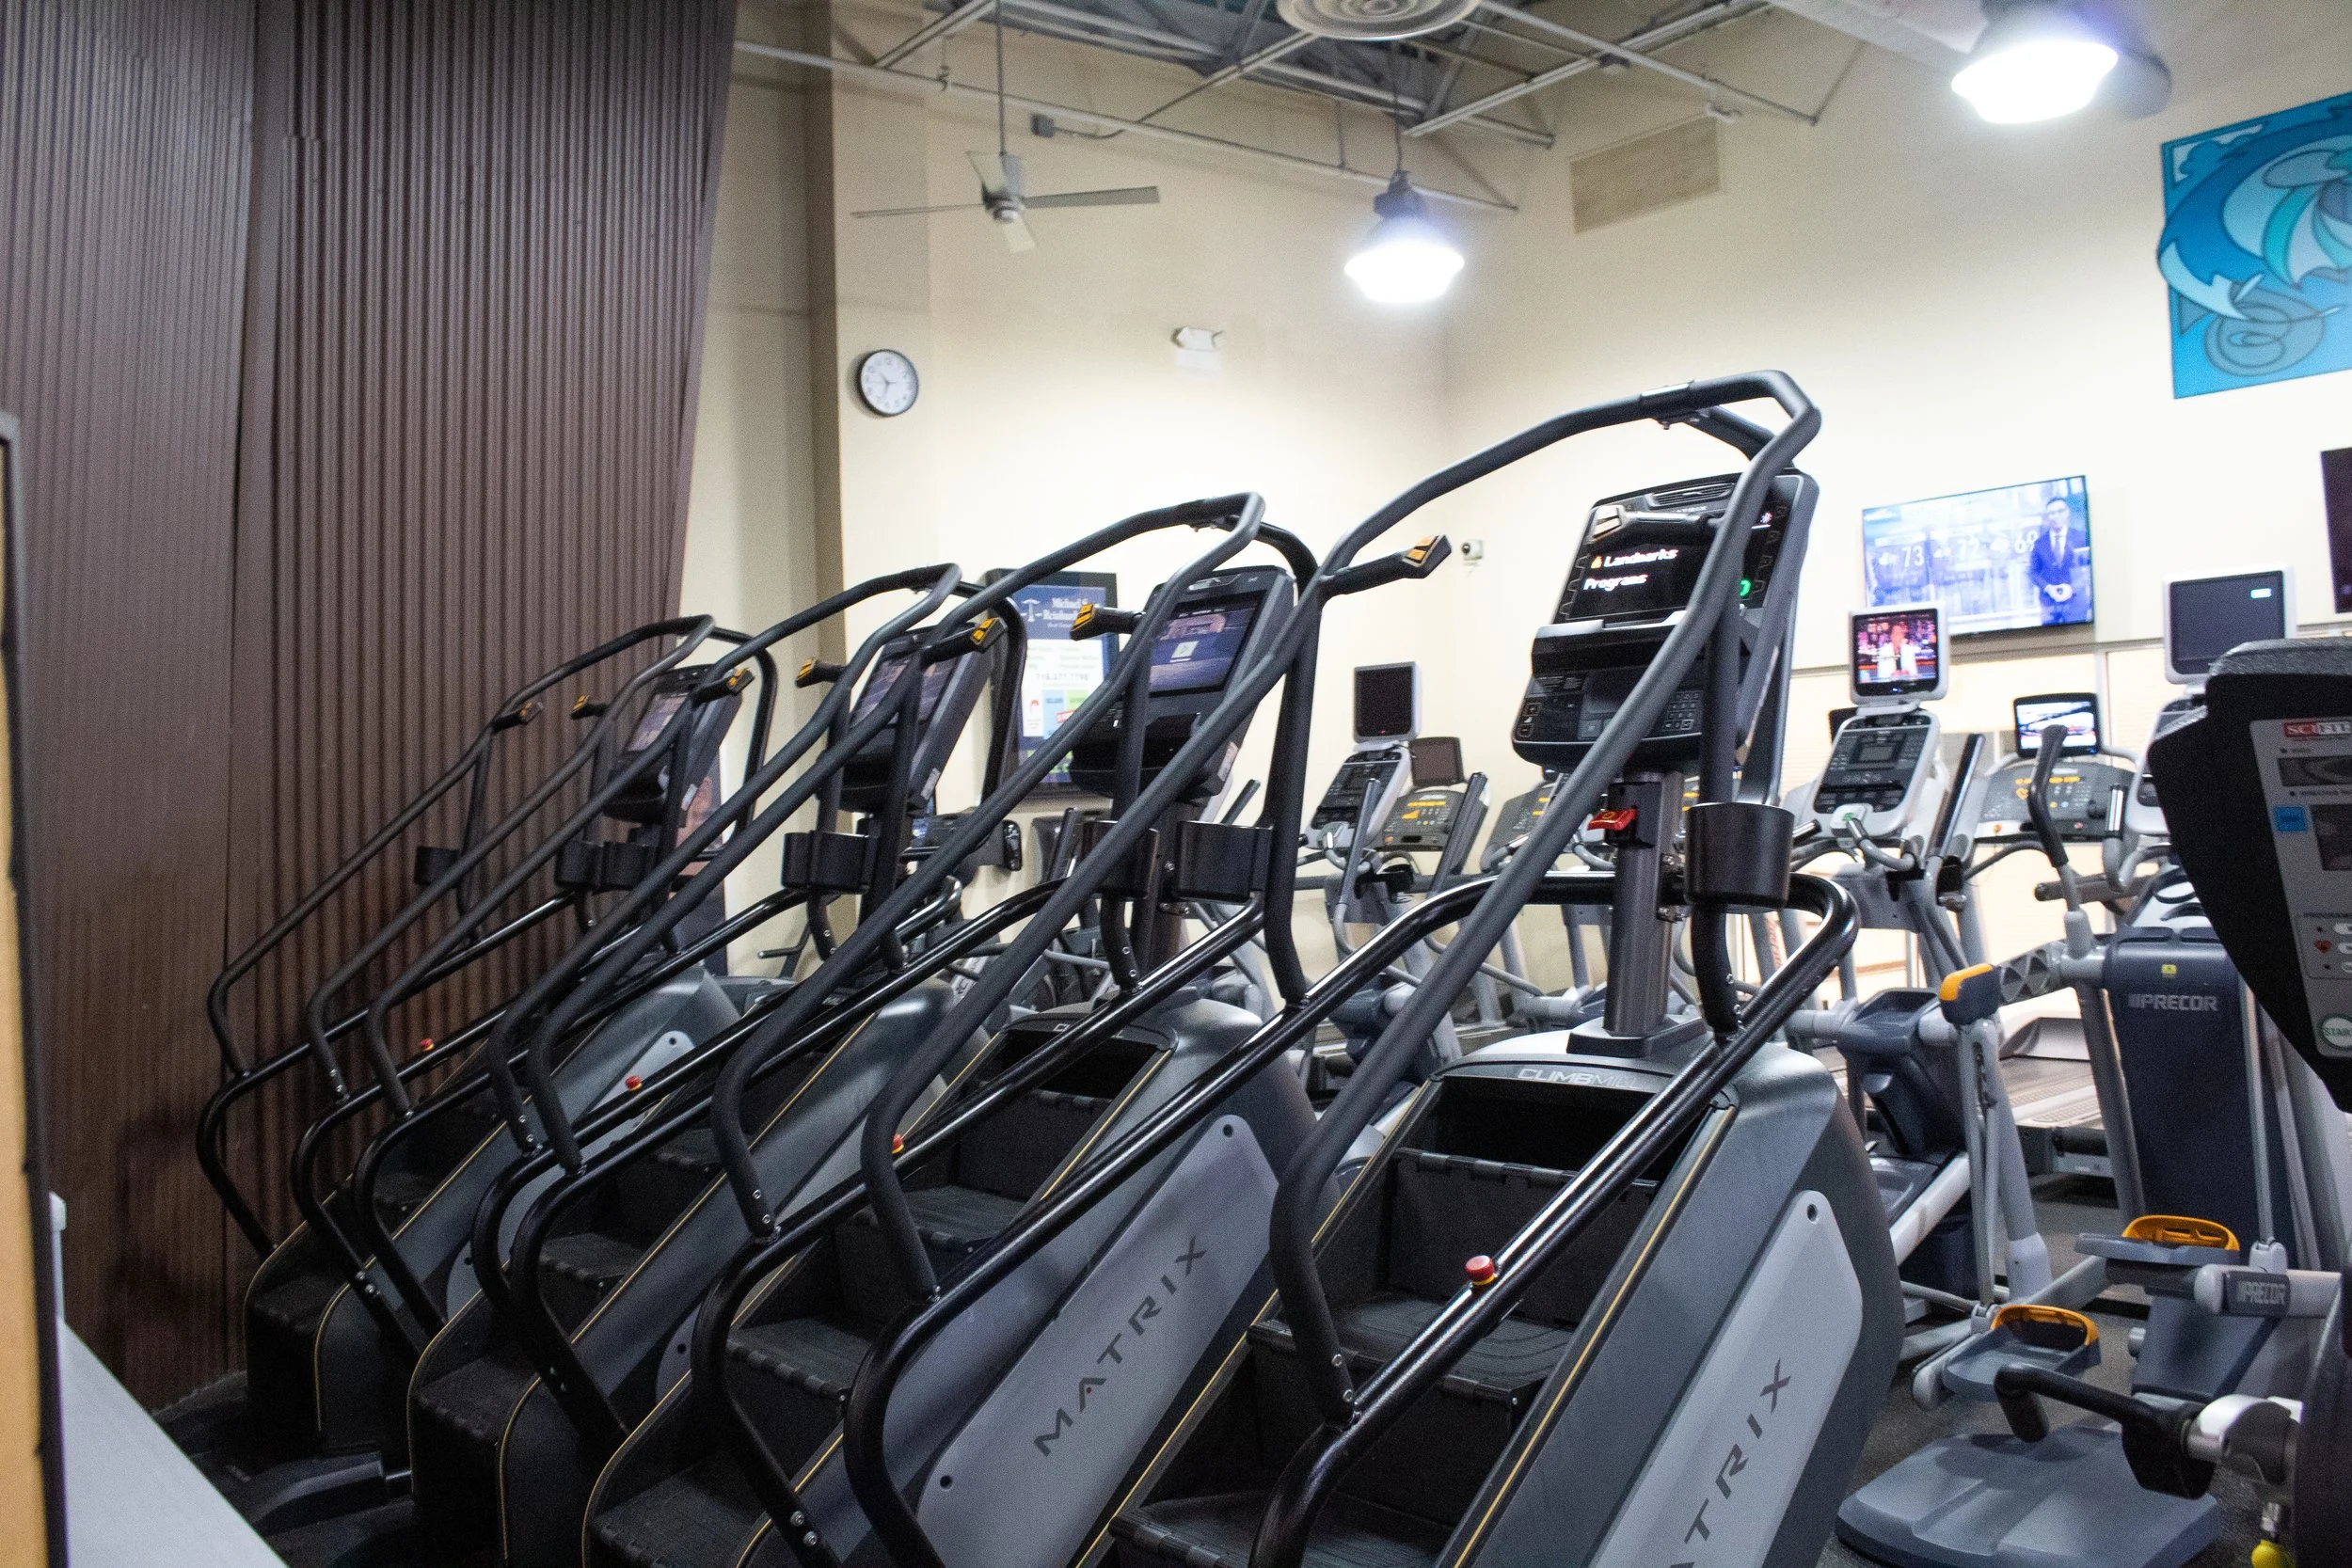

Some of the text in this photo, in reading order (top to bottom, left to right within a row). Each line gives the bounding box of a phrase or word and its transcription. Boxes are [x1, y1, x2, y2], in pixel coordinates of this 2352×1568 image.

[1603, 548, 1678, 568] Landmarks
[1900, 545, 1925, 567] 73
[1582, 574, 1648, 592] Programs
[2140, 993, 2218, 1011] PRECOR
[1518, 1069, 1642, 1089] CLIMBMILL
[1034, 1236, 1208, 1457] MATRIX
[1670, 1357, 1792, 1568] TRIX
